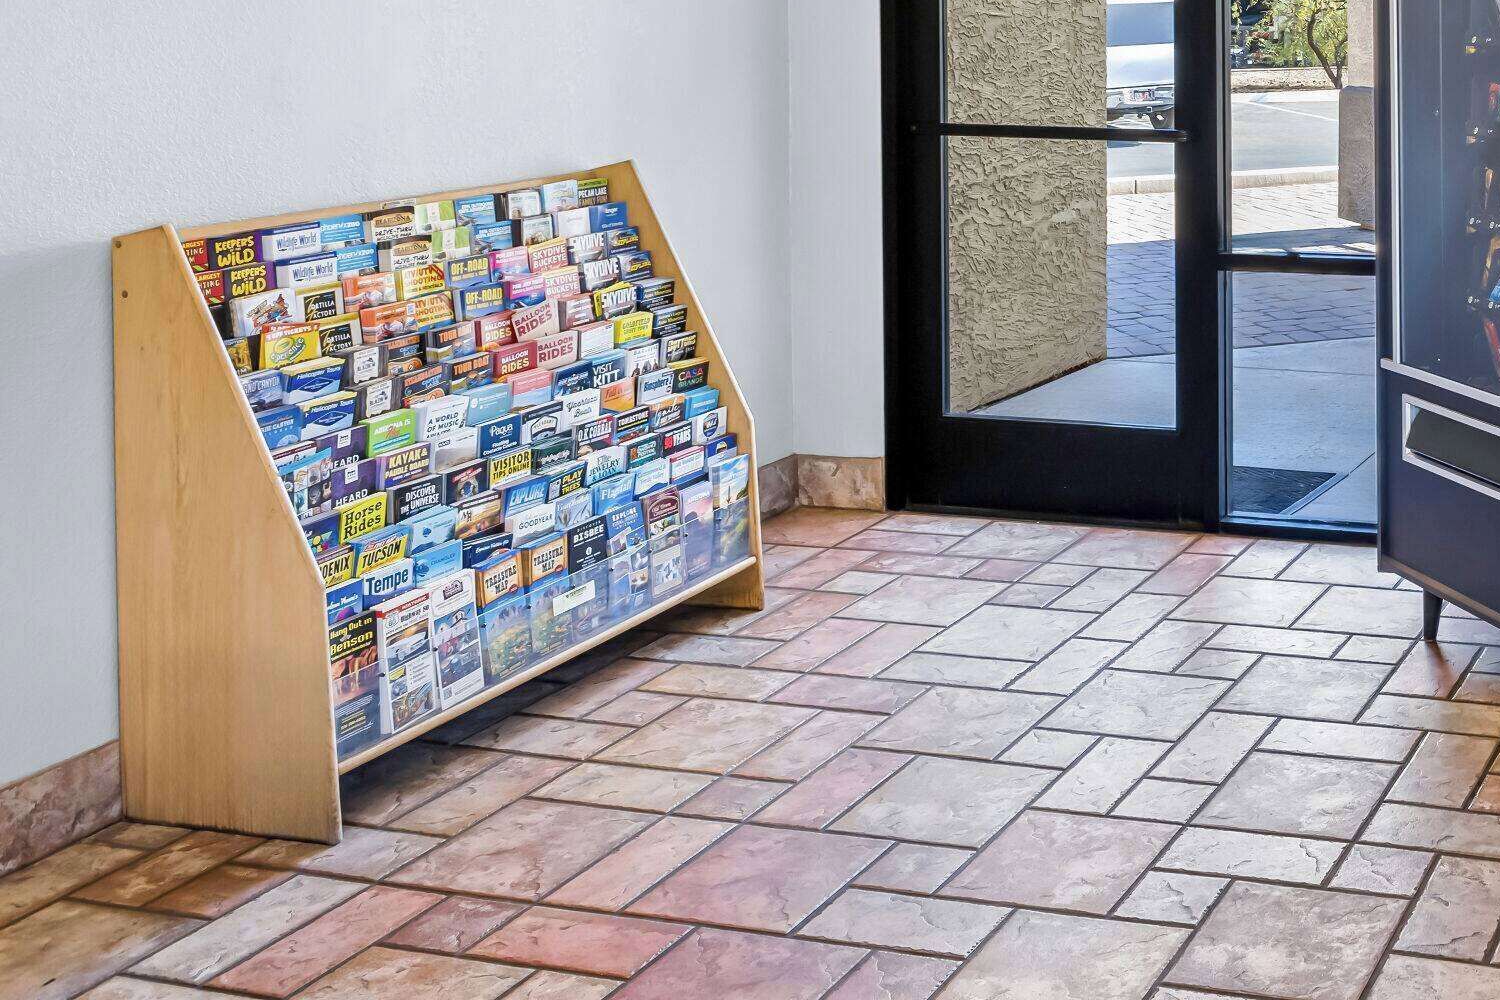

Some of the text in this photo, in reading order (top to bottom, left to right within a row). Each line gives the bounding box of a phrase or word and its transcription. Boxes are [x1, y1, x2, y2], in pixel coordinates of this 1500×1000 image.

[183, 240, 205, 249] ARGEST
[215, 235, 255, 254] KEEPERS
[532, 245, 567, 261] SKYDIVE
[217, 248, 255, 268] WILD
[451, 257, 489, 276] OFF-ROAD
[534, 255, 568, 273] BUCKEYE
[230, 265, 267, 283] KEEPERS
[546, 274, 579, 290] SKYDIVE
[231, 277, 267, 297] WILD
[465, 286, 504, 305] OFF-ROAD
[547, 283, 579, 300] BUCKEYE
[601, 285, 638, 303] SKYDIVE
[514, 303, 551, 327] BALLOON
[517, 310, 554, 337] RIDES
[484, 319, 511, 332] BALLOON
[438, 329, 456, 345] TOUR
[484, 328, 513, 343] RIDES
[538, 336, 574, 354] BALLOON
[538, 343, 574, 364] RIDES
[501, 350, 529, 365] BALLOON
[296, 369, 326, 381] Helicopter
[452, 364, 471, 378] TOUR
[501, 358, 530, 376] RIDES
[592, 361, 613, 378] VISIT
[677, 367, 704, 381] CASA
[592, 369, 620, 388] KITT
[311, 401, 338, 415] Helicopter
[436, 411, 460, 425] WORLD
[426, 420, 463, 435] OF MUSIC
[333, 453, 361, 469] EARD
[389, 450, 420, 470] KAYAK
[493, 450, 530, 471] VISITOR
[493, 467, 509, 482] TIPS
[508, 461, 531, 477] ONLINE
[405, 484, 437, 501] DISCOVER
[562, 481, 582, 495] TREES
[335, 488, 368, 508] HEARD
[411, 493, 440, 510] UNIVERSE
[344, 500, 382, 527] Horse
[519, 513, 553, 531] GOODYEAR
[344, 516, 382, 541] Rides
[573, 522, 606, 545] BISBEE
[361, 538, 402, 569] TUCSON
[533, 544, 566, 568] TREASURE
[319, 555, 352, 579] OENIX
[541, 558, 557, 574] MAP
[364, 565, 410, 595] Tempe
[485, 563, 518, 589] TREASURE
[494, 578, 511, 596] MAP
[329, 624, 349, 642] Hang
[348, 617, 363, 632] Out
[330, 630, 374, 656] Benson
